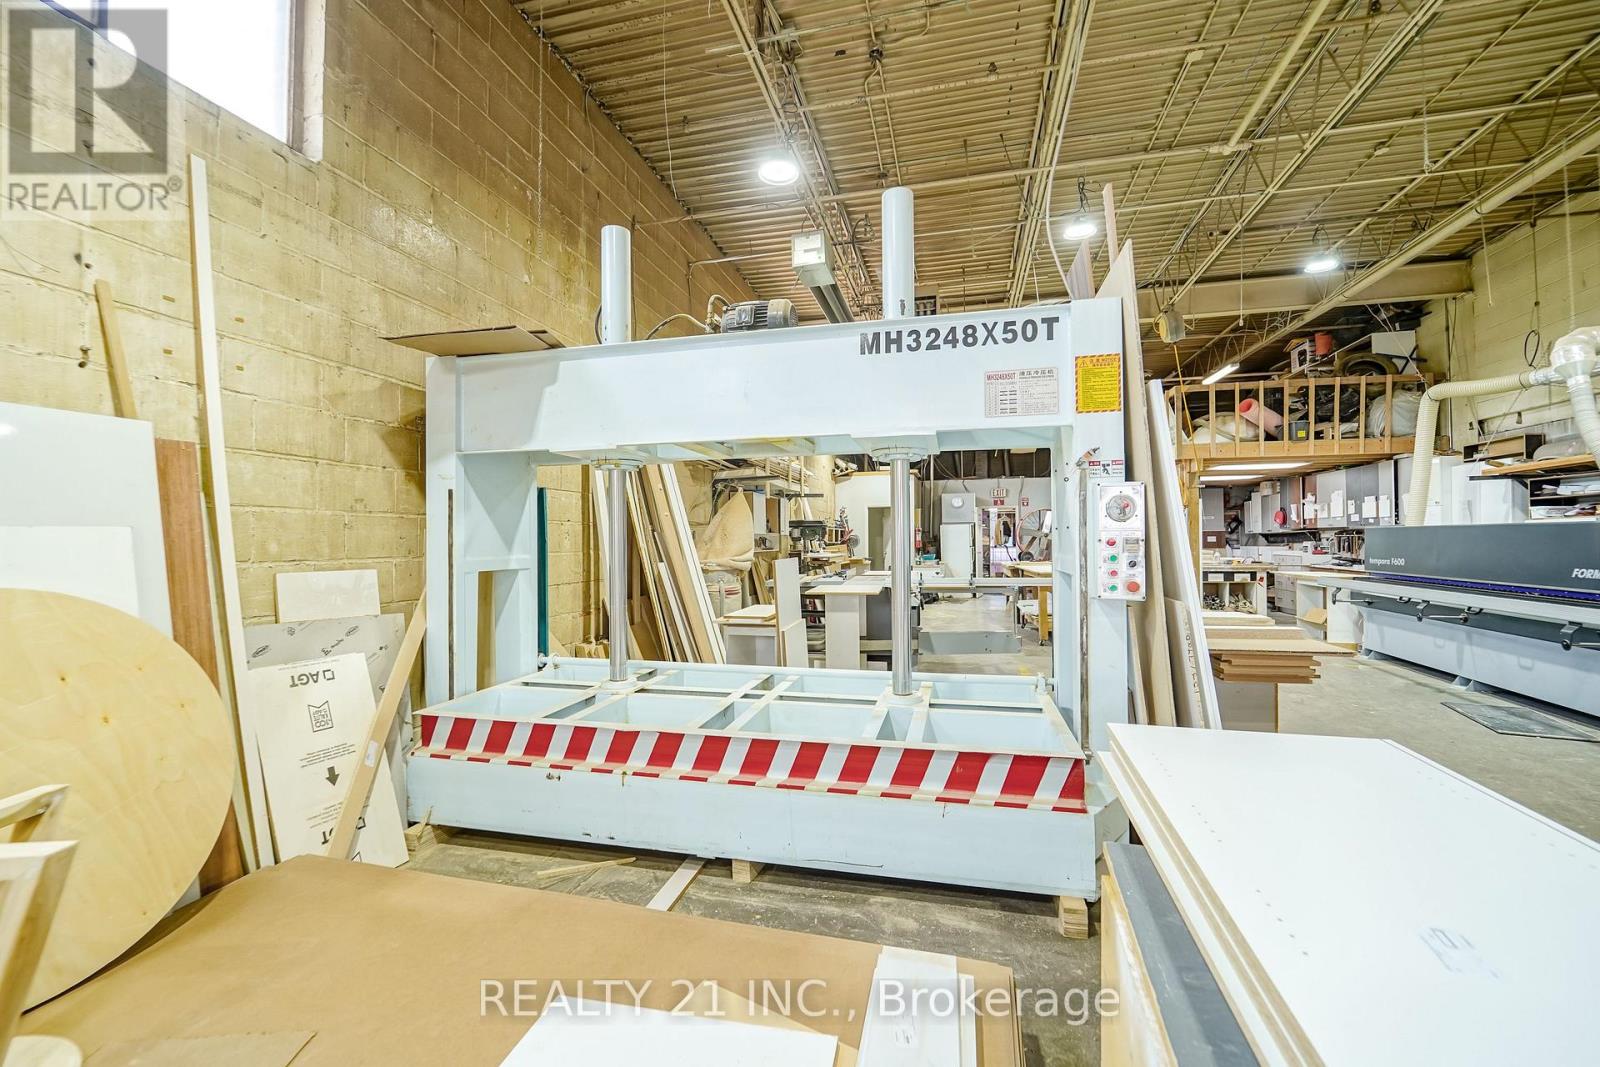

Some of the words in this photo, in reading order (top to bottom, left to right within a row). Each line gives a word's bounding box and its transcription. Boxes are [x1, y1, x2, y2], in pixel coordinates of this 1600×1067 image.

[859, 316, 1060, 355] MH3248X50T
[992, 488, 1005, 497] EXIT
[1391, 557, 1406, 566] F600
[288, 670, 320, 688] AGT
